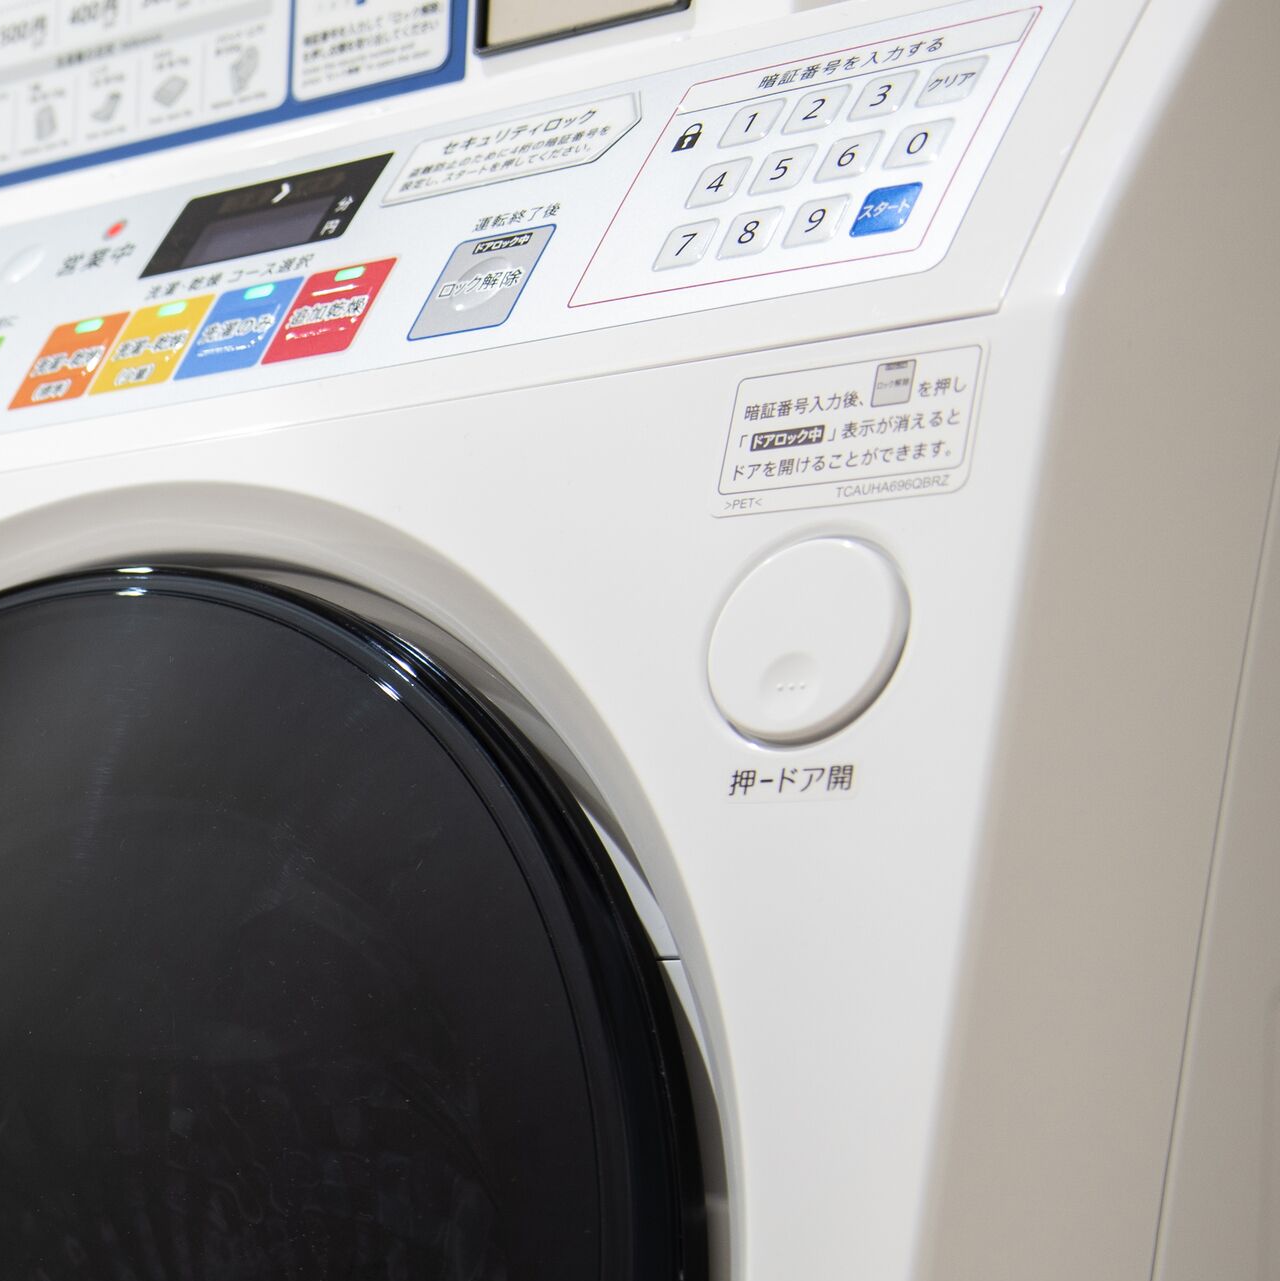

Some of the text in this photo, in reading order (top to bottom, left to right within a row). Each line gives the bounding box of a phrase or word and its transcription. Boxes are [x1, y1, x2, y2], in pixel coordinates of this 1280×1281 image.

[758, 37, 945, 89] 暗証番号を入力する
[926, 70, 977, 93] クリア
[746, 84, 892, 134] 1 2 3
[443, 110, 597, 155] セキュリティロック
[706, 131, 929, 193] 4 5 6 0
[321, 219, 340, 235] 円
[472, 202, 561, 233] 運転終了後
[857, 197, 911, 221] スタート
[473, 233, 531, 254] ドアロック中
[675, 208, 827, 257] 7 8 9
[56, 242, 136, 277] 営業中
[438, 268, 523, 299] ロック解除
[744, 376, 968, 422] 暗証番号入力後、 を押し
[732, 441, 952, 482] ドアを開けることができます。
